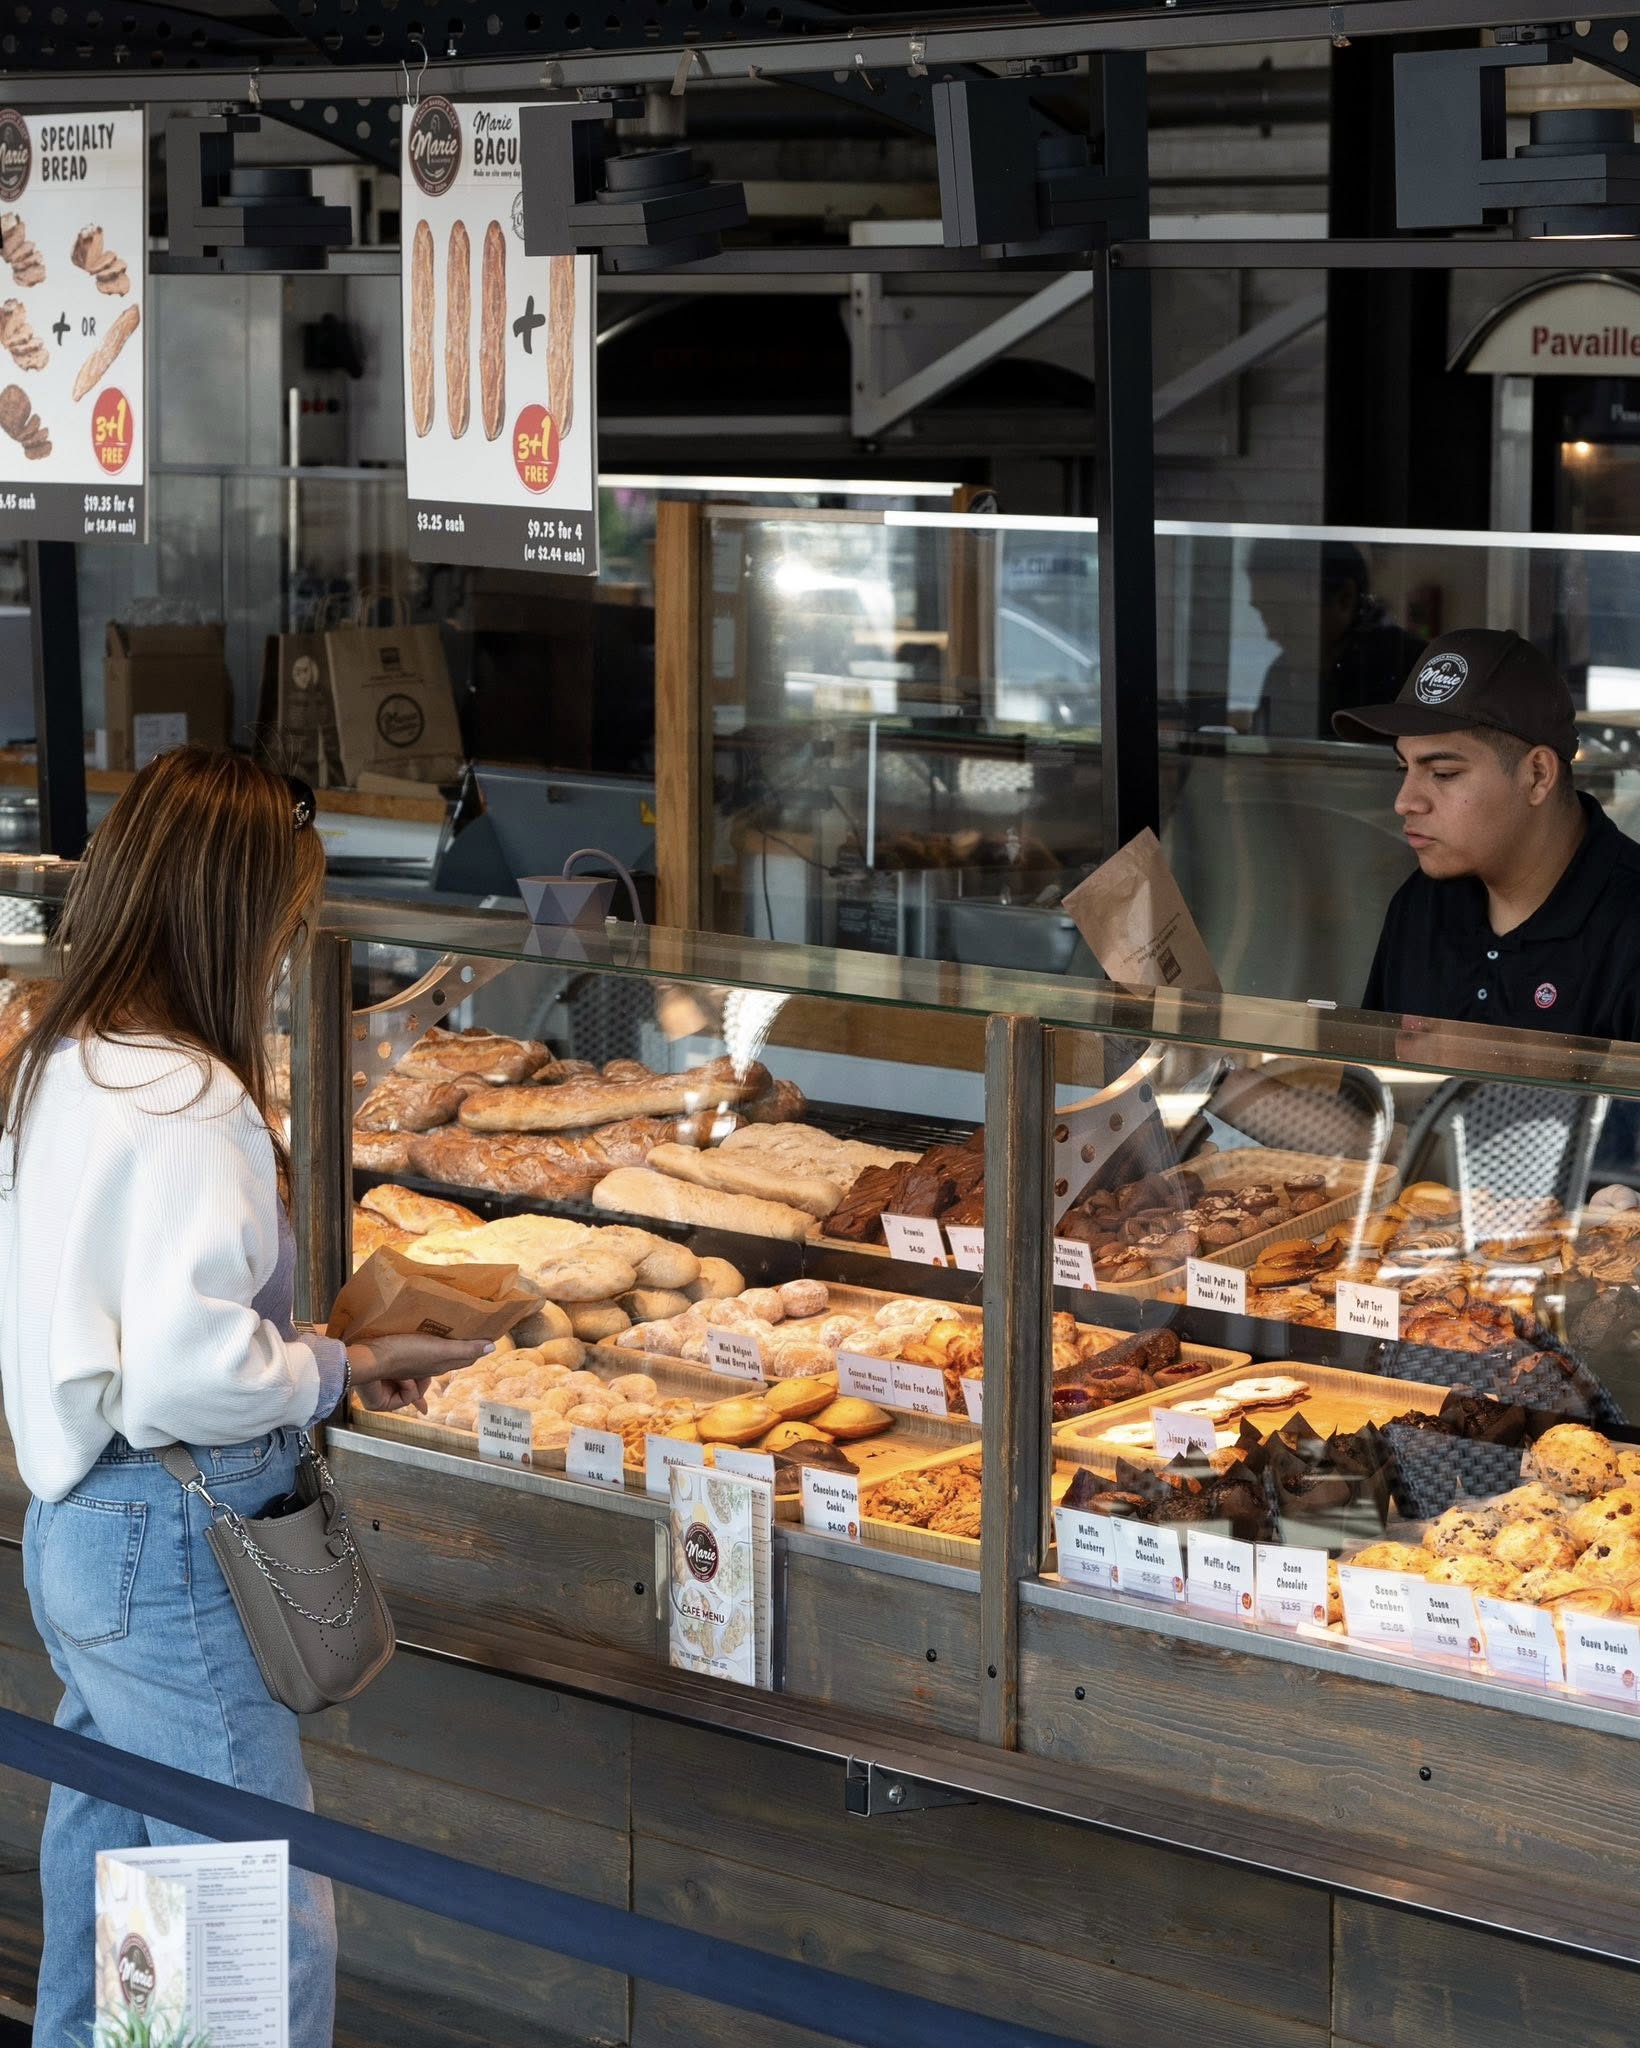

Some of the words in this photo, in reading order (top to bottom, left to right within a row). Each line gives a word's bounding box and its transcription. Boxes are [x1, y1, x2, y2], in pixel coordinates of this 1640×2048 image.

[473, 110, 512, 138] Marie
[41, 122, 114, 152] SPECIALTY
[410, 129, 459, 165] Marie
[474, 137, 522, 167] BAGU
[42, 154, 88, 182] BREAD
[81, 316, 97, 338] OR
[95, 398, 128, 443] 3+1
[517, 415, 552, 461] 3+1
[101, 446, 125, 465] FREE
[524, 465, 549, 483] FREE
[18, 493, 36, 511] each
[84, 494, 112, 513] $19.35
[113, 494, 126, 513] for
[128, 496, 135, 513] 4
[84, 517, 95, 535] (or
[118, 518, 137, 536] each)
[417, 512, 442, 532] $3.25
[445, 513, 465, 533] each
[527, 519, 555, 540] $9.75
[557, 520, 572, 540] for
[574, 523, 583, 541] 4
[524, 544, 536, 562] (or
[537, 545, 562, 562] $2.44
[564, 547, 586, 565] each)
[1420, 667, 1461, 686] Marie
[909, 1245, 925, 1255] $4.50
[1196, 1272, 1212, 1284] Small
[1213, 1276, 1226, 1288] Puff
[1227, 1279, 1238, 1291] Tart
[1198, 1286, 1214, 1299] Peach
[1214, 1290, 1219, 1300] /
[1220, 1292, 1236, 1305] Apple
[1356, 1298, 1370, 1310] Puff
[1371, 1300, 1383, 1312] Tart
[1349, 1311, 1366, 1324] Peach
[1366, 1314, 1372, 1324] /
[1373, 1316, 1389, 1329] Apple
[894, 1379, 912, 1391] Gluten
[913, 1383, 925, 1394] Free
[926, 1386, 944, 1398] Cookie
[490, 1413, 502, 1425] Mini
[584, 1441, 606, 1455] WAFFLE
[663, 1455, 684, 1466] Madelei
[812, 1482, 840, 1498] Chocolate
[841, 1488, 858, 1503] Chips
[826, 1500, 846, 1514] Cookie
[827, 1521, 847, 1533] $4.00
[1078, 1524, 1099, 1538] Muffin
[685, 1540, 717, 1563] Marie
[1075, 1538, 1105, 1557] Blueberry
[1137, 1535, 1159, 1550] Muffin
[1135, 1549, 1165, 1566] Chocolate
[1203, 1555, 1224, 1570] Muffin
[1226, 1560, 1241, 1573] Corn
[1282, 1561, 1302, 1574] Scone
[1213, 1580, 1232, 1593] $3.95
[1276, 1577, 1308, 1591] Chocolate
[1374, 1584, 1398, 1597] Scone
[1429, 1597, 1450, 1610] Scone
[702, 1609, 725, 1624] MENU
[1426, 1612, 1460, 1629] Blueberry
[1507, 1623, 1537, 1639] Palmier
[1516, 1646, 1538, 1659] $3.95
[1580, 1635, 1602, 1651] Guava
[1604, 1640, 1629, 1656] Danish
[1595, 1662, 1617, 1675] $3.95
[118, 1956, 154, 1988] Marie
